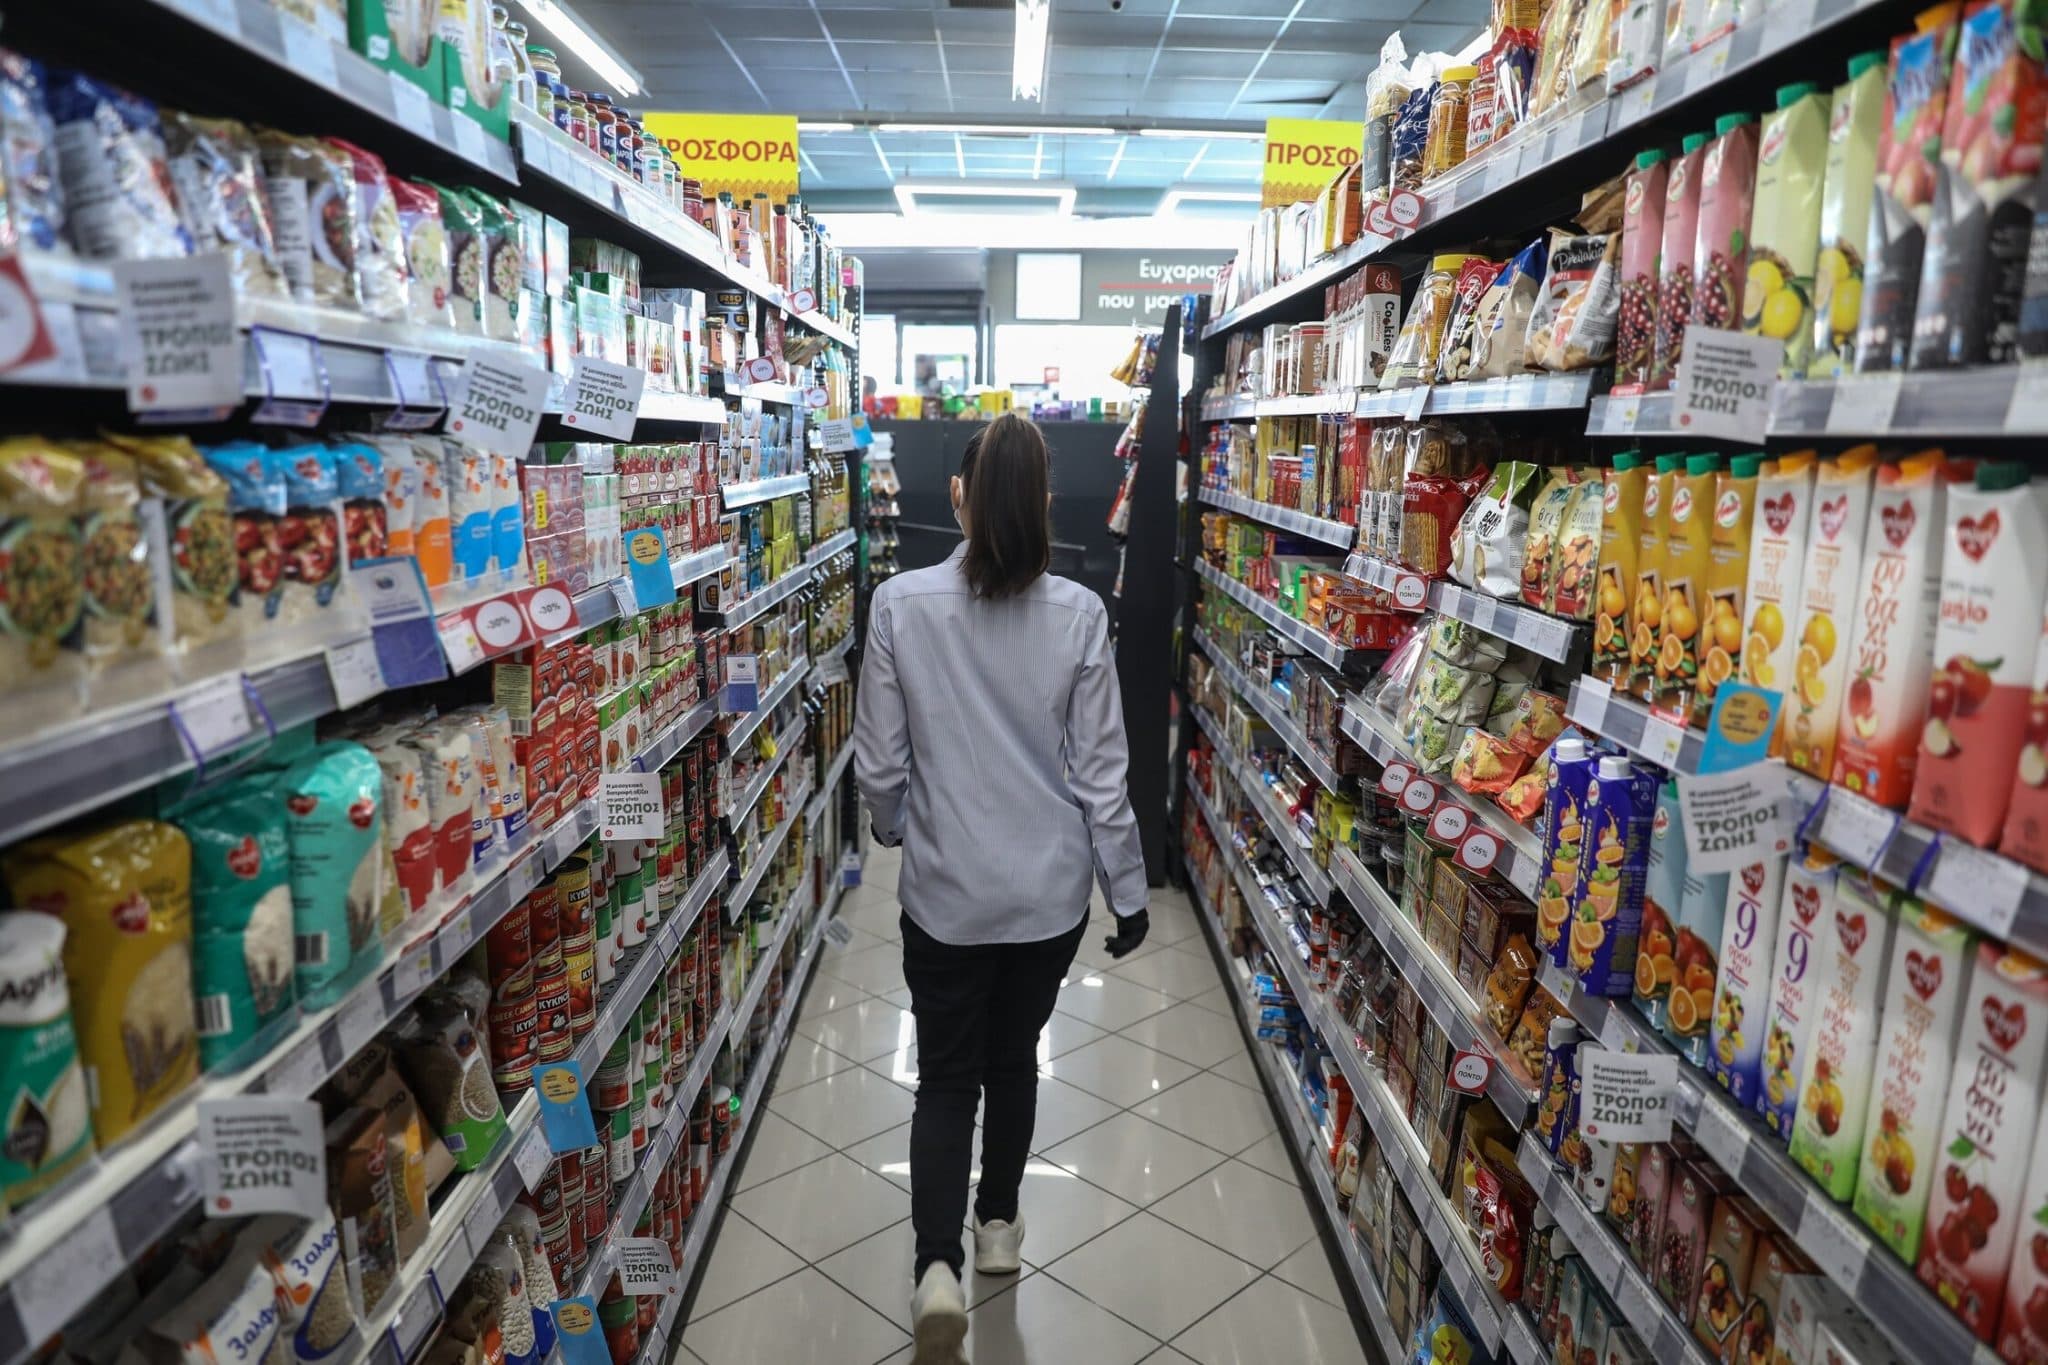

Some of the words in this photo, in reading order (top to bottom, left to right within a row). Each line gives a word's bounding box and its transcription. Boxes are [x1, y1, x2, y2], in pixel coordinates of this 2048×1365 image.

[1098, 294, 1134, 310] που
[1691, 374, 1769, 402] ΤΡΟΠΟΣ
[467, 388, 535, 425] ΤΡΟΠΟΣ
[578, 388, 635, 412] ΤΡΟΠΟΣ
[1688, 392, 1739, 415] ΖΩΗΣ
[462, 404, 507, 431] ΖΩΗΣ
[574, 401, 613, 421] ΖΩΗΣ
[538, 602, 561, 614] -30%
[1388, 772, 1404, 783] -25%
[607, 802, 660, 814] ΤΡΟΠΟΣ
[608, 815, 643, 826] ΖΩΗΣ
[1442, 817, 1460, 829] -25%
[1694, 803, 1779, 836] ΤΡΟΠΟΣ
[1697, 829, 1757, 853] ΖΩΗΣ
[1471, 845, 1489, 859] -25%
[1733, 901, 1757, 951] 9
[1784, 931, 1808, 983] 9
[1457, 1070, 1483, 1081] ΠΟΝΤΟΙ
[1592, 1091, 1667, 1110] ΤΡΟΠΟΣ
[1592, 1107, 1643, 1125] ΖΩΗΣ
[219, 1149, 318, 1175] ΤΡΟΠΟΣ
[220, 1169, 293, 1190] ΖΩΗΣ
[625, 1263, 671, 1274] ΤΡΟΠΟΣ
[626, 1273, 659, 1283] ΖΩΗΣ
